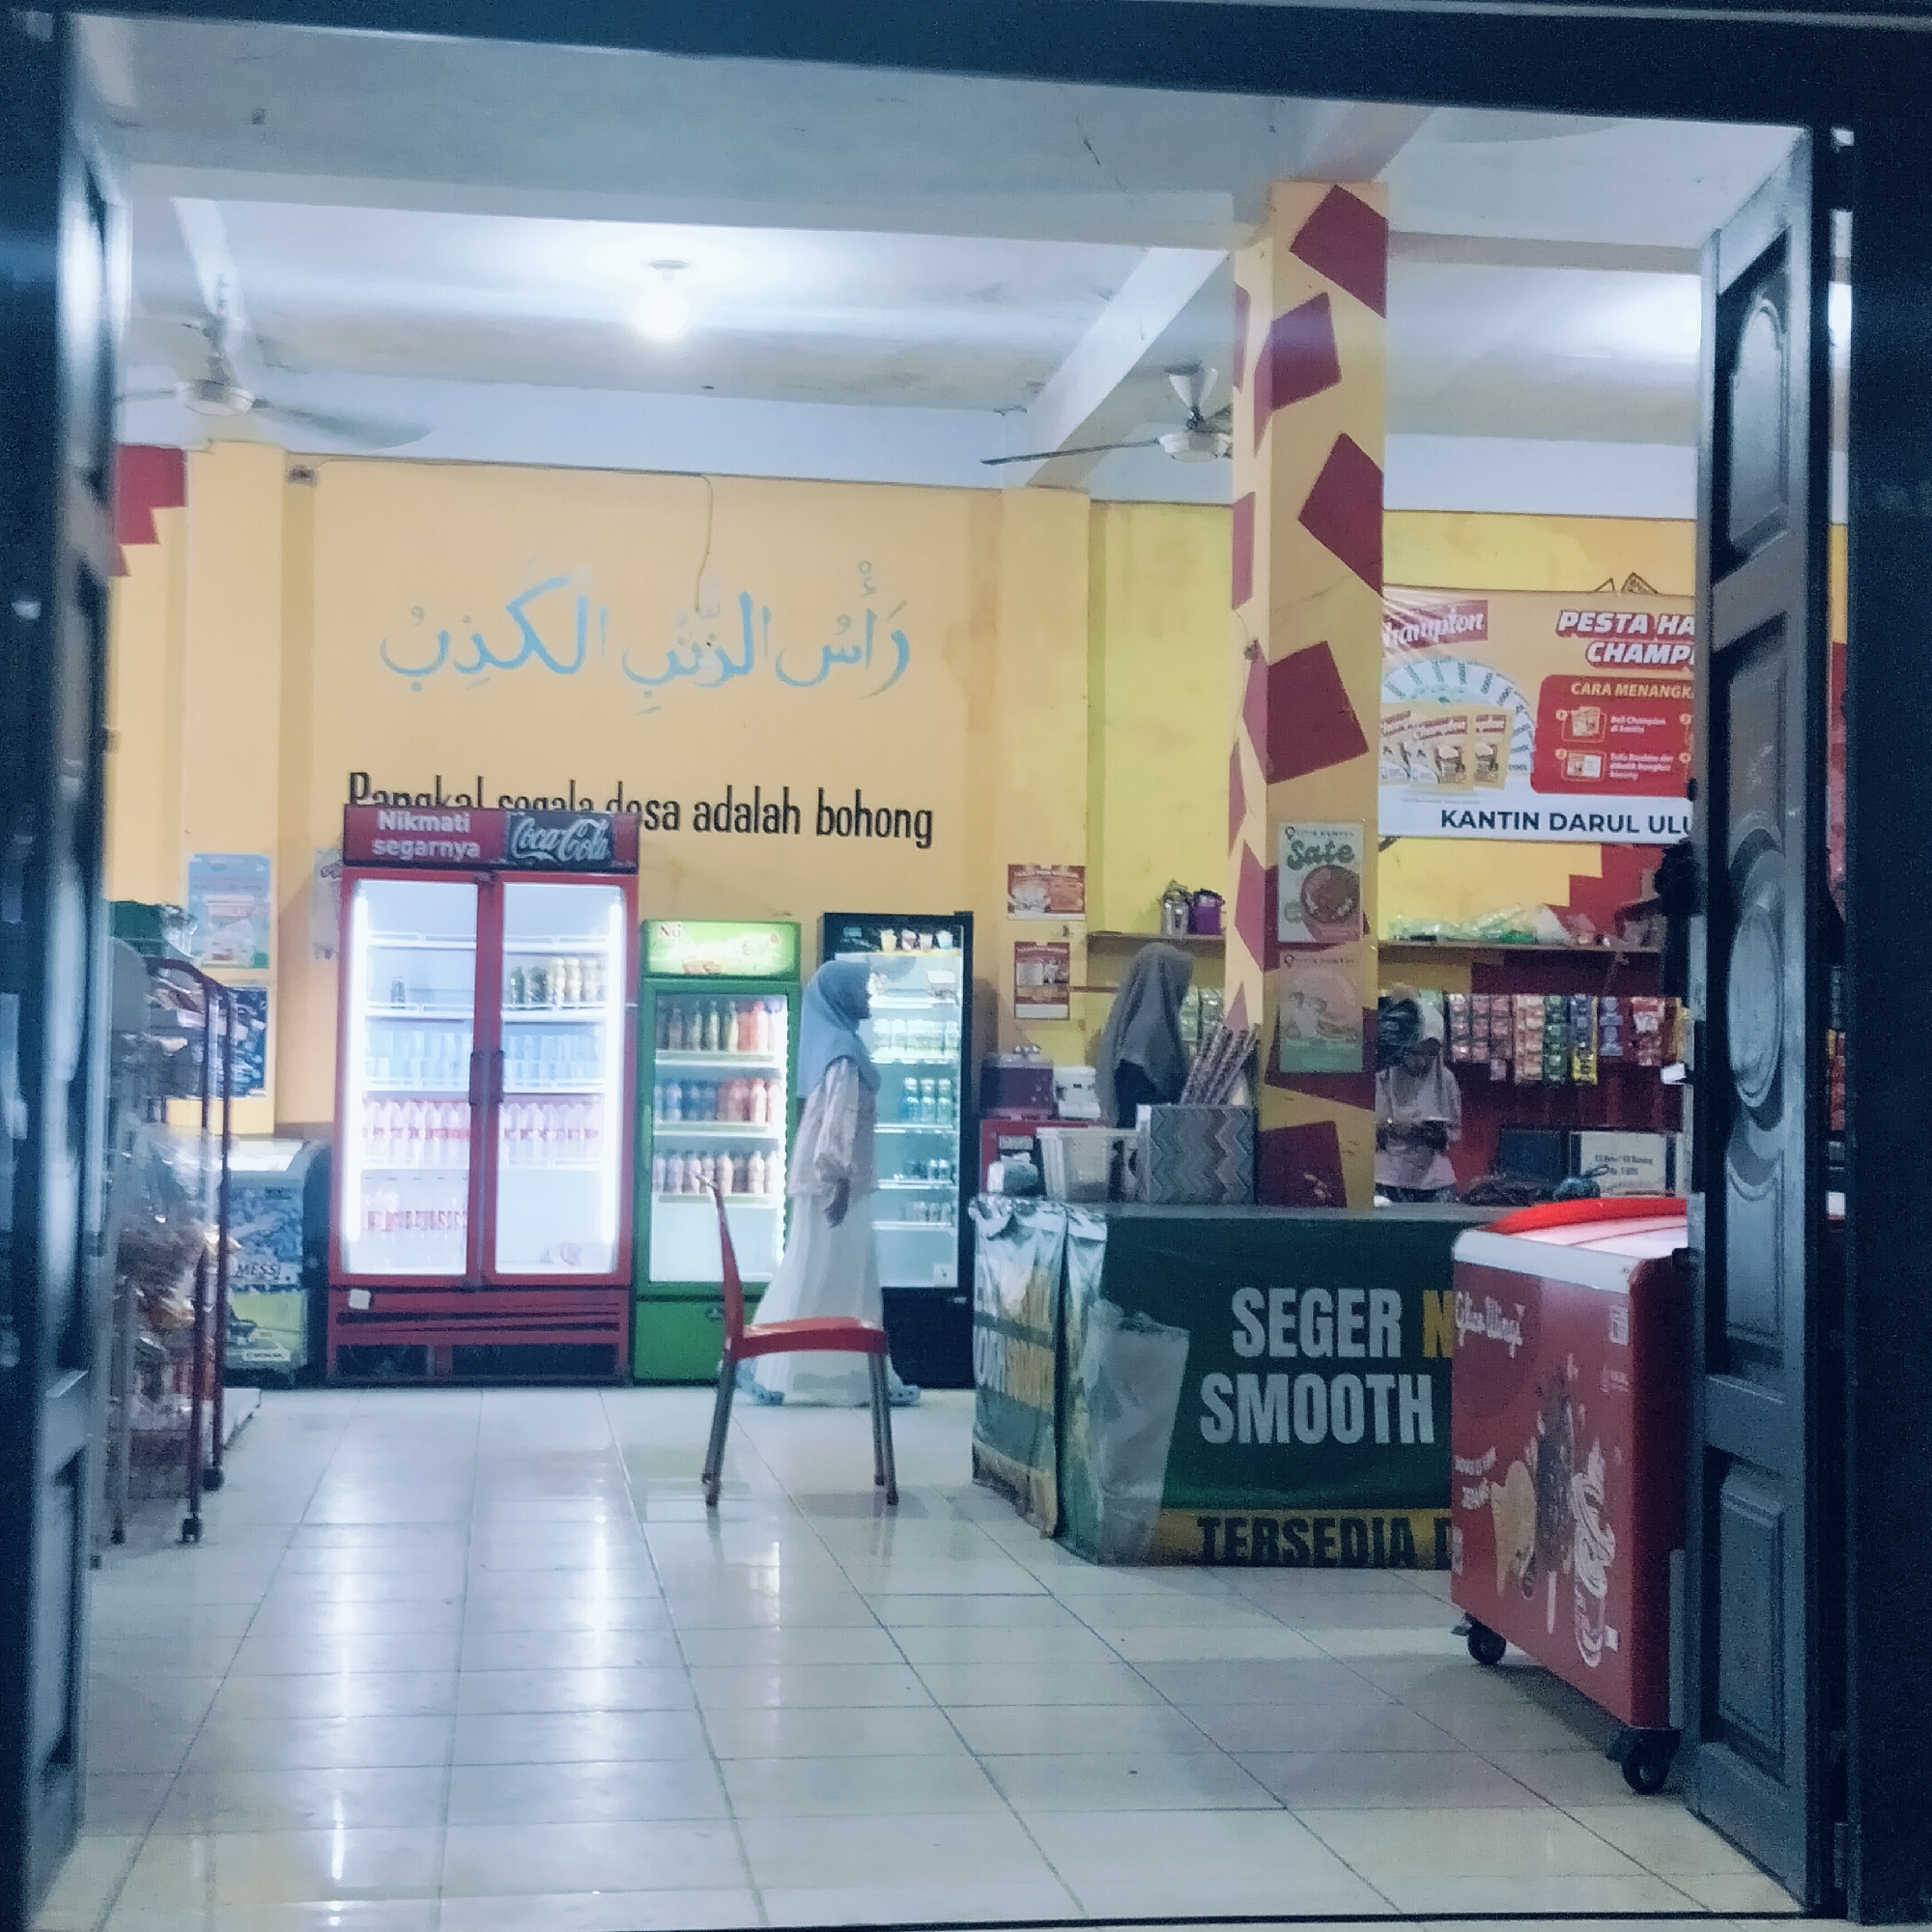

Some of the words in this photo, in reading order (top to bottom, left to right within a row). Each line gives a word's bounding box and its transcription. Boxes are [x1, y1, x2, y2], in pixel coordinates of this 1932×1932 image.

[1557, 611, 1649, 635] PESTA
[1571, 682, 1611, 696] CARA
[1614, 683, 1694, 699] MENANGK
[377, 810, 471, 833] Nikmati
[693, 784, 801, 835] adalah
[816, 786, 933, 849] bohong
[1441, 810, 1540, 831] KANTIN
[1548, 812, 1639, 834] DARUL
[372, 838, 481, 860] segarnya
[1287, 839, 1355, 870] Sate
[1232, 1287, 1402, 1358] SEGER
[1200, 1372, 1435, 1444] SMOOTH
[1196, 1516, 1416, 1568] TERSEDIA
